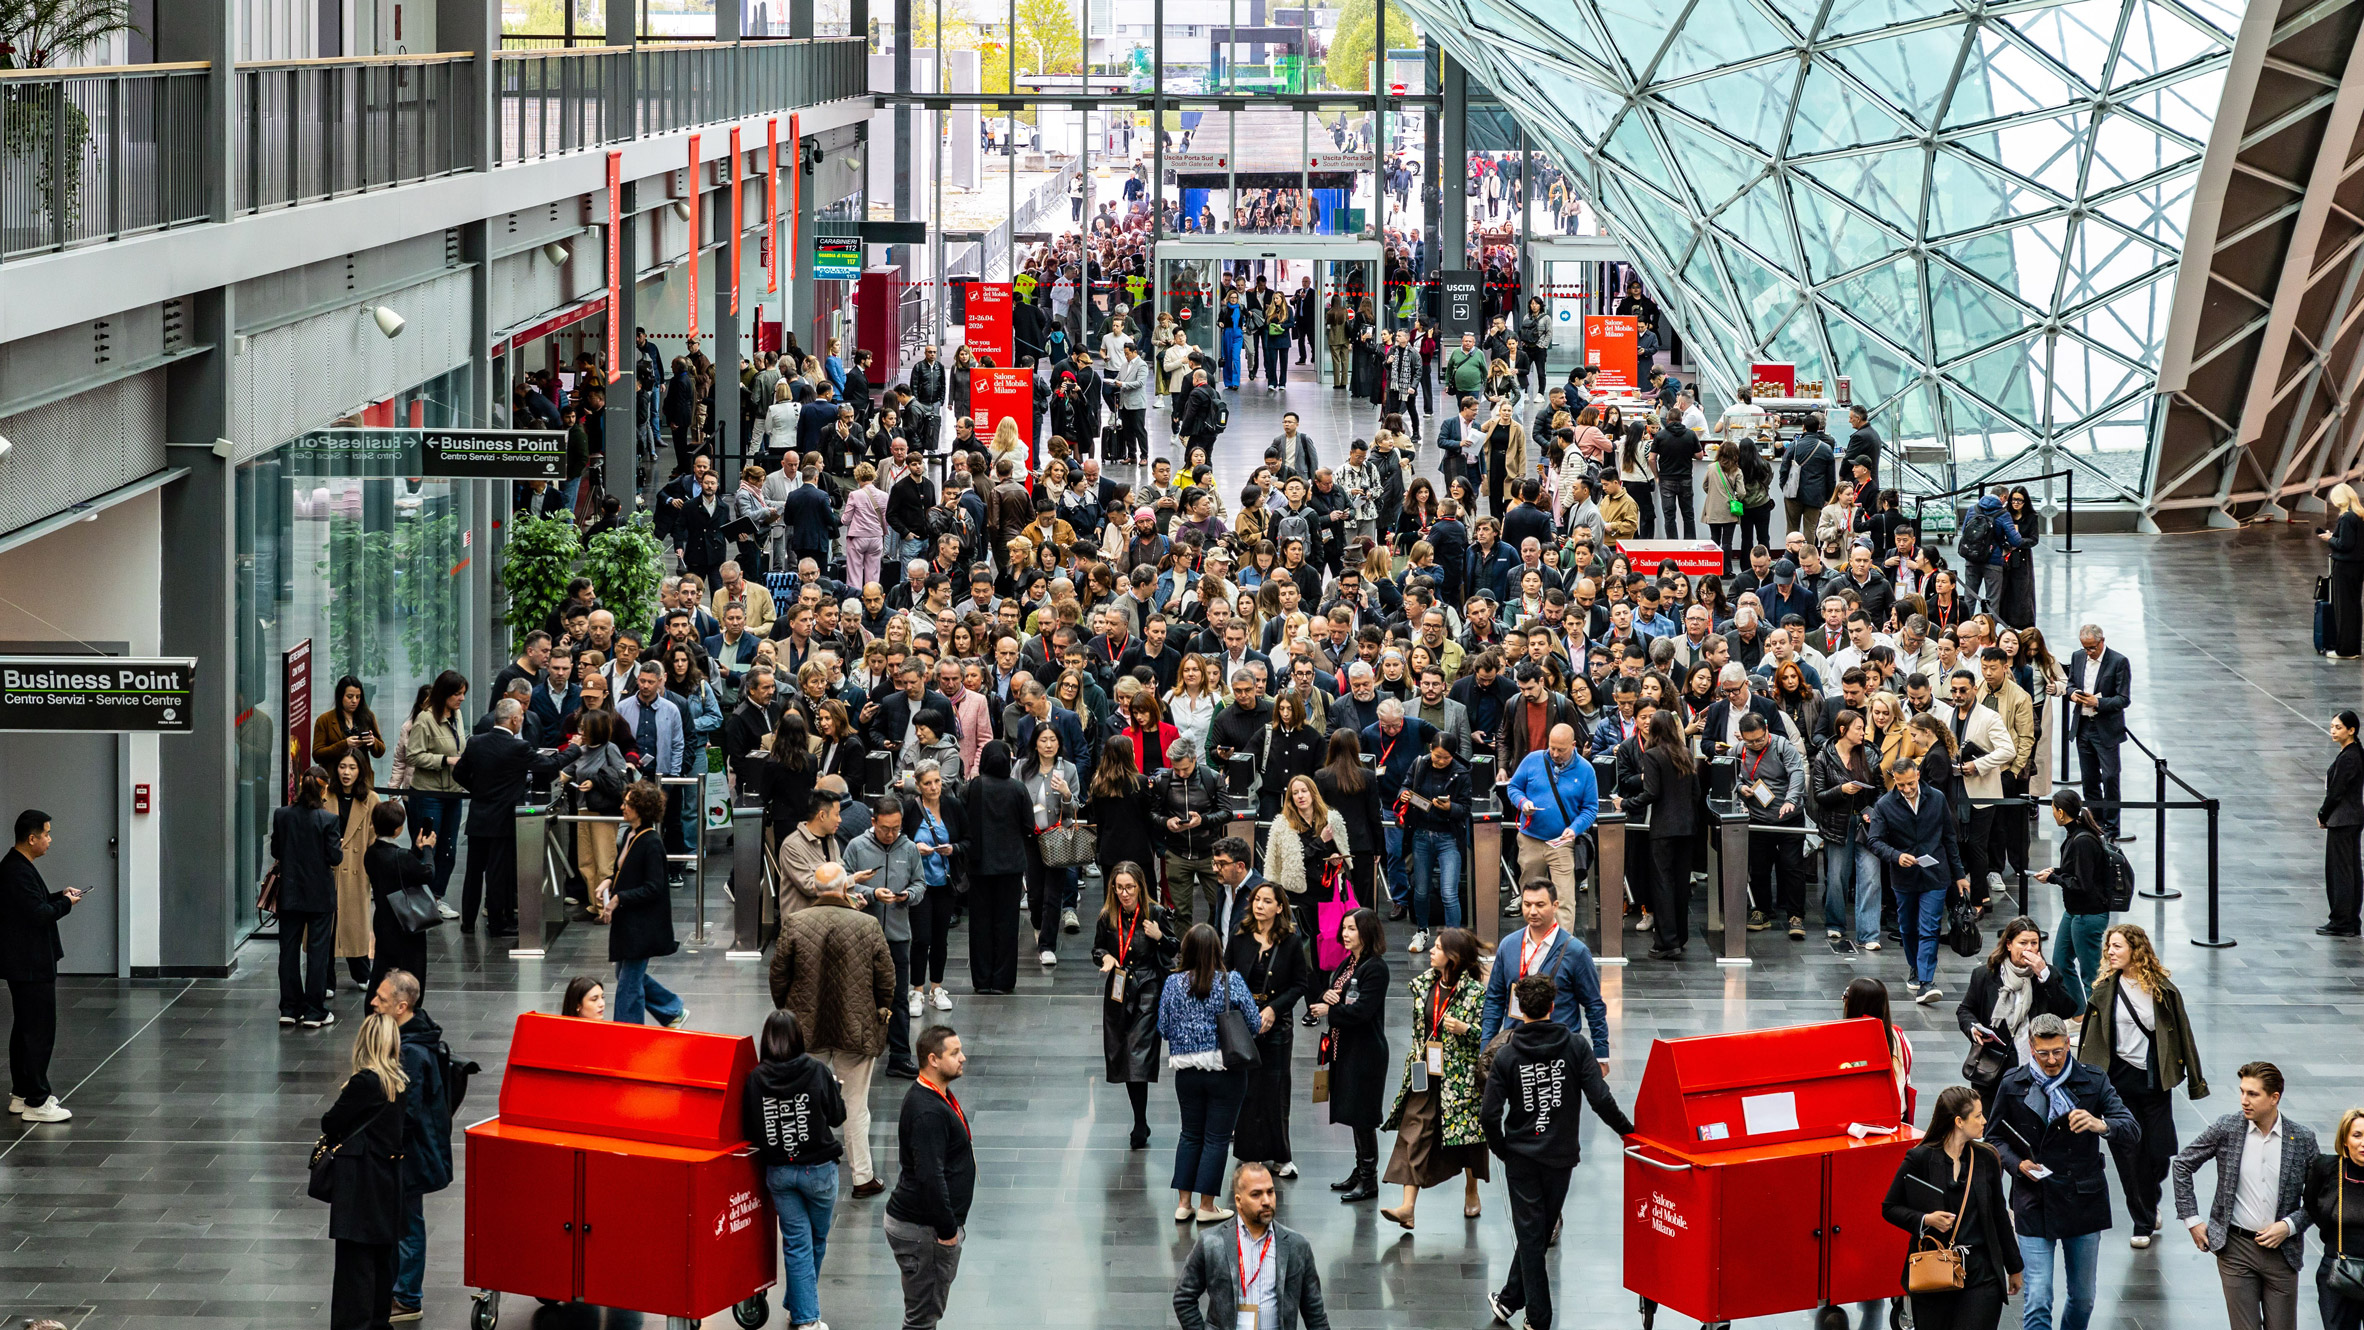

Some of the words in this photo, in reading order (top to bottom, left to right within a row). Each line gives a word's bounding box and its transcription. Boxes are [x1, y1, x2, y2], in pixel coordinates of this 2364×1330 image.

[441, 436, 513, 451] Business
[518, 438, 559, 452] Point
[440, 452, 468, 461] Centro
[469, 453, 495, 462] Servizi
[502, 453, 531, 462] Service
[532, 454, 560, 463] Centre
[4, 669, 112, 690] Business
[119, 670, 180, 690] Point
[4, 693, 44, 705] Centro
[47, 694, 86, 706] Servizi
[96, 694, 140, 706] Service
[142, 694, 182, 706] Centre
[1535, 1062, 1551, 1084] del
[1550, 1059, 1566, 1107] Salone
[1519, 1063, 1536, 1112] Milano
[762, 1096, 779, 1146] Milano
[794, 1093, 811, 1142] Salone
[1535, 1086, 1552, 1136] Mobile.
[729, 1190, 751, 1207] Salone
[1652, 1190, 1676, 1211] Salone
[729, 1205, 740, 1220] del
[1652, 1204, 1663, 1219] del
[1663, 1208, 1688, 1230] Mobile.
[729, 1217, 752, 1234] Milano
[1652, 1216, 1676, 1238] Milano
